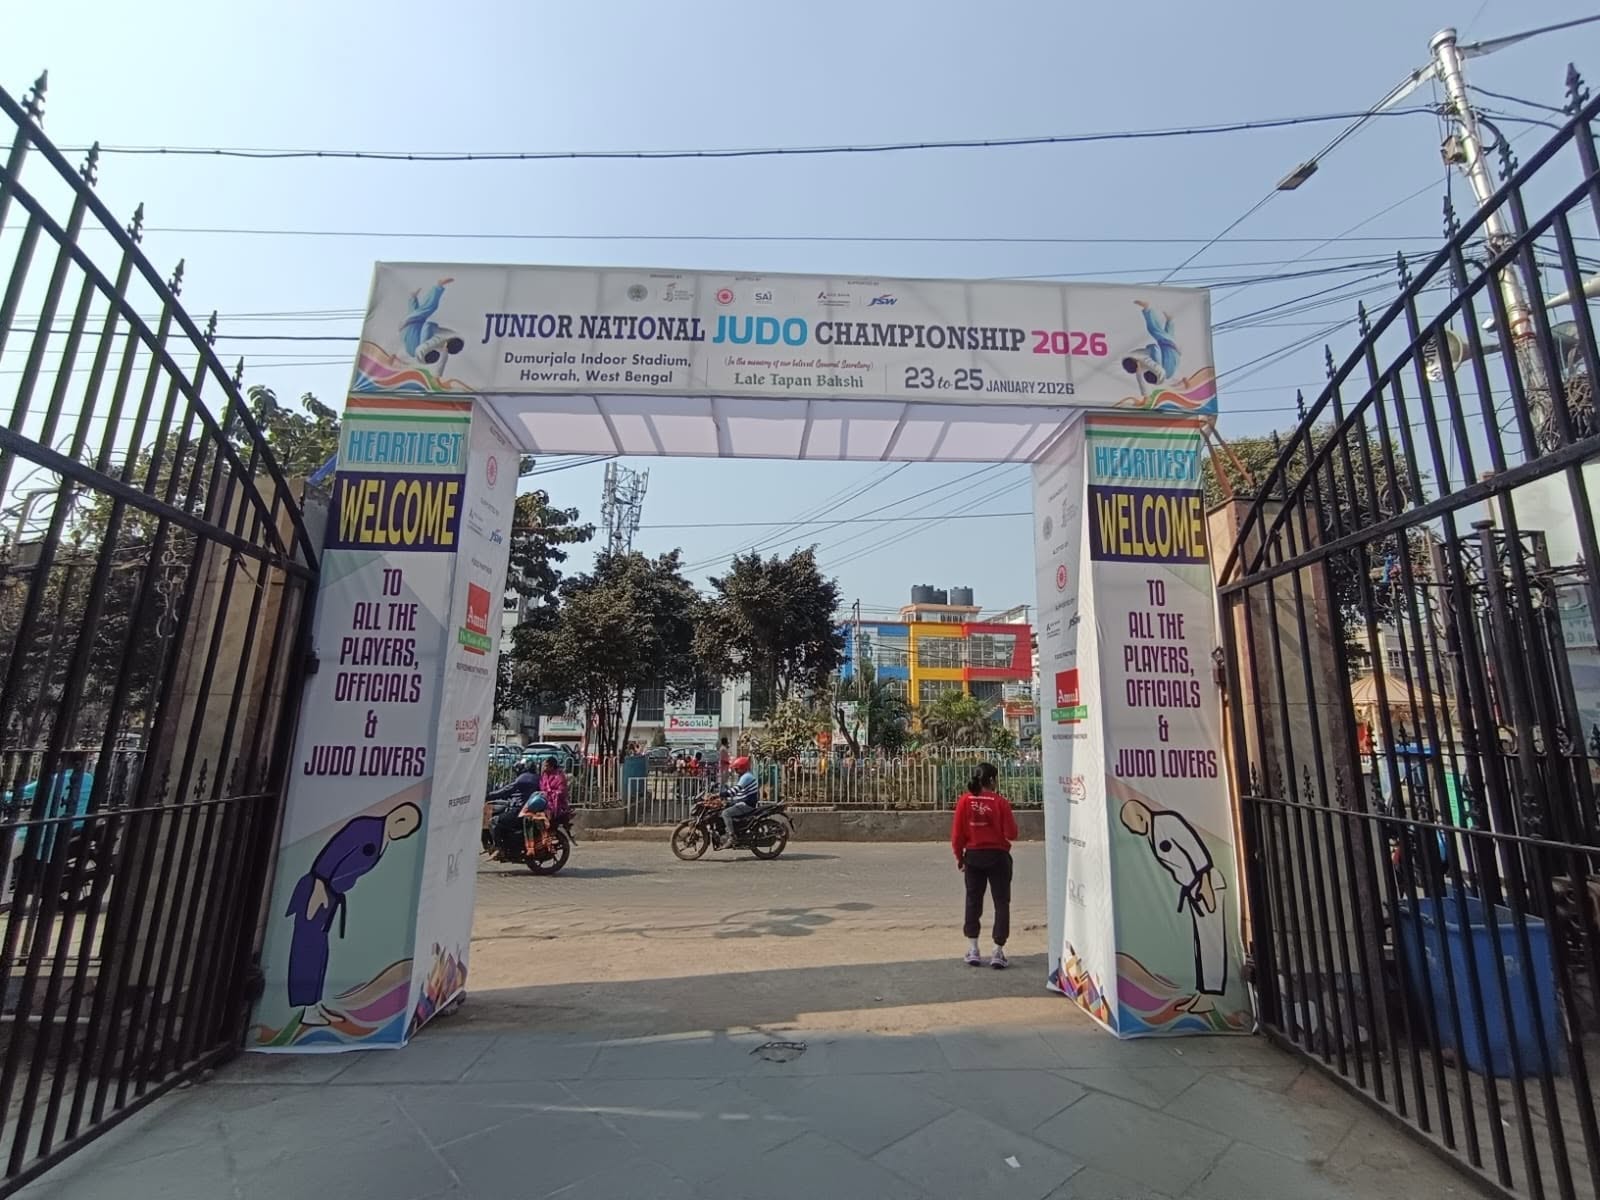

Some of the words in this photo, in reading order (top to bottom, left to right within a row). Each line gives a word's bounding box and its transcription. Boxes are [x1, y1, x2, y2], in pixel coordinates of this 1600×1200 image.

[482, 313, 573, 344] JUNIOR
[578, 315, 705, 342] NATIONAL
[712, 315, 808, 346] JUDO
[815, 321, 1026, 352] CHAMPIONSHIP
[1031, 330, 1108, 357] 2026
[504, 352, 576, 367] Dumurjala
[581, 353, 627, 365] Indoor
[632, 354, 692, 367] Stadium,
[520, 369, 580, 382] Howrah,
[586, 370, 620, 382] West
[625, 371, 673, 385] Bengal
[734, 373, 766, 385] Late
[769, 373, 812, 389] Tapan
[816, 374, 864, 388] Bakshi
[905, 367, 935, 389] 23
[938, 376, 950, 390] to
[954, 368, 984, 391] 25
[986, 380, 1035, 394] JANUARY
[1037, 382, 1075, 395] 2026
[348, 430, 463, 466] HEARTIEST
[1095, 446, 1198, 481] HEARTIEST
[339, 478, 458, 546] WELCOME
[1096, 493, 1205, 558] WELCOME
[383, 569, 403, 596] TO
[1146, 580, 1165, 606] TO
[352, 602, 381, 631] ALL
[388, 603, 418, 631] THE
[1129, 612, 1155, 639] ALL
[1157, 613, 1185, 640] THE
[339, 637, 419, 670] PLAYERS,
[1124, 645, 1194, 677] PLAYERS,
[335, 672, 422, 703] OFFICIALS
[1126, 679, 1201, 708] OFFICIALS
[364, 710, 378, 738] &
[1158, 715, 1169, 742] &
[303, 746, 356, 777] JUDO
[359, 747, 426, 777] LOVERS
[1115, 749, 1157, 778] JUDO
[1160, 750, 1218, 778] LOVERS
